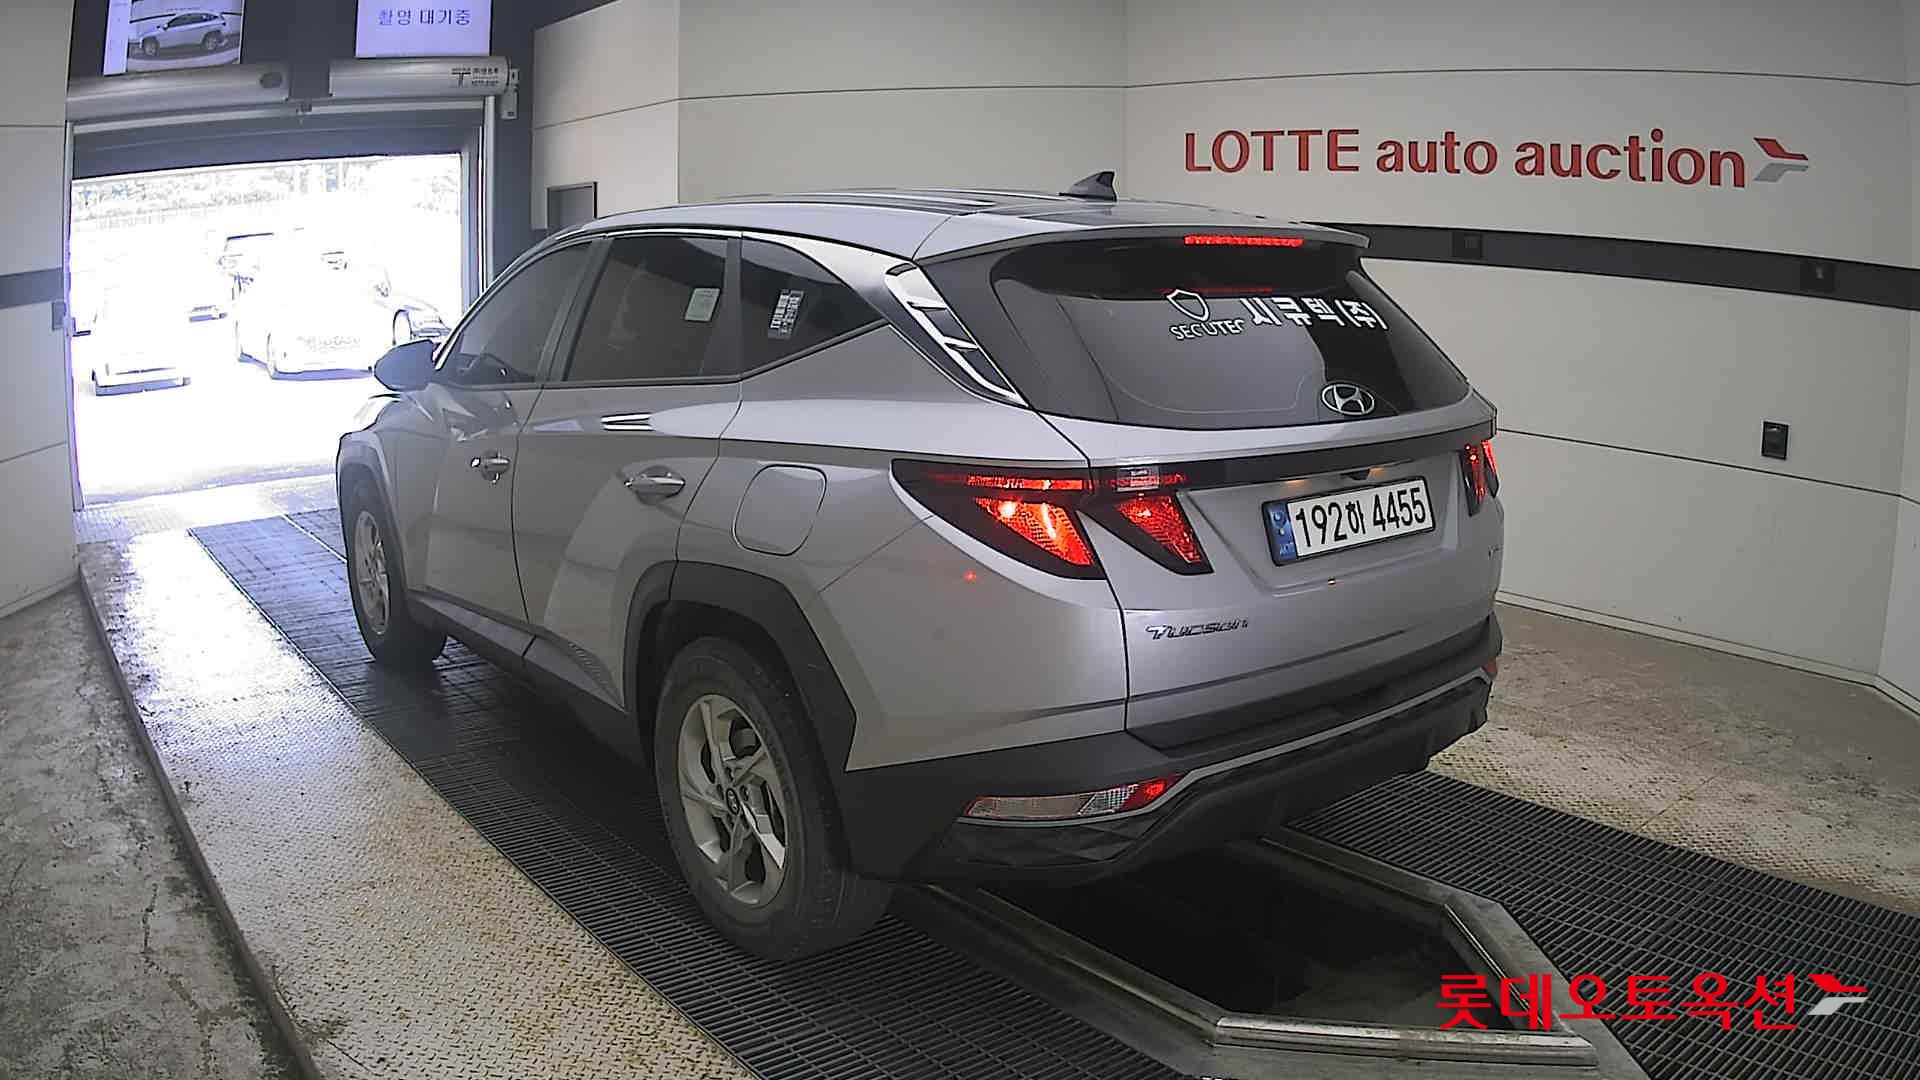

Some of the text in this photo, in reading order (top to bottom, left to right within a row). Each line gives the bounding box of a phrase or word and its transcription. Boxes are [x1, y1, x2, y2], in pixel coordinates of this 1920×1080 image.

[419, 8, 471, 26] 대기중
[1185, 129, 1746, 188] LOTTE auto auction
[1295, 487, 1427, 548] 192하 4455
